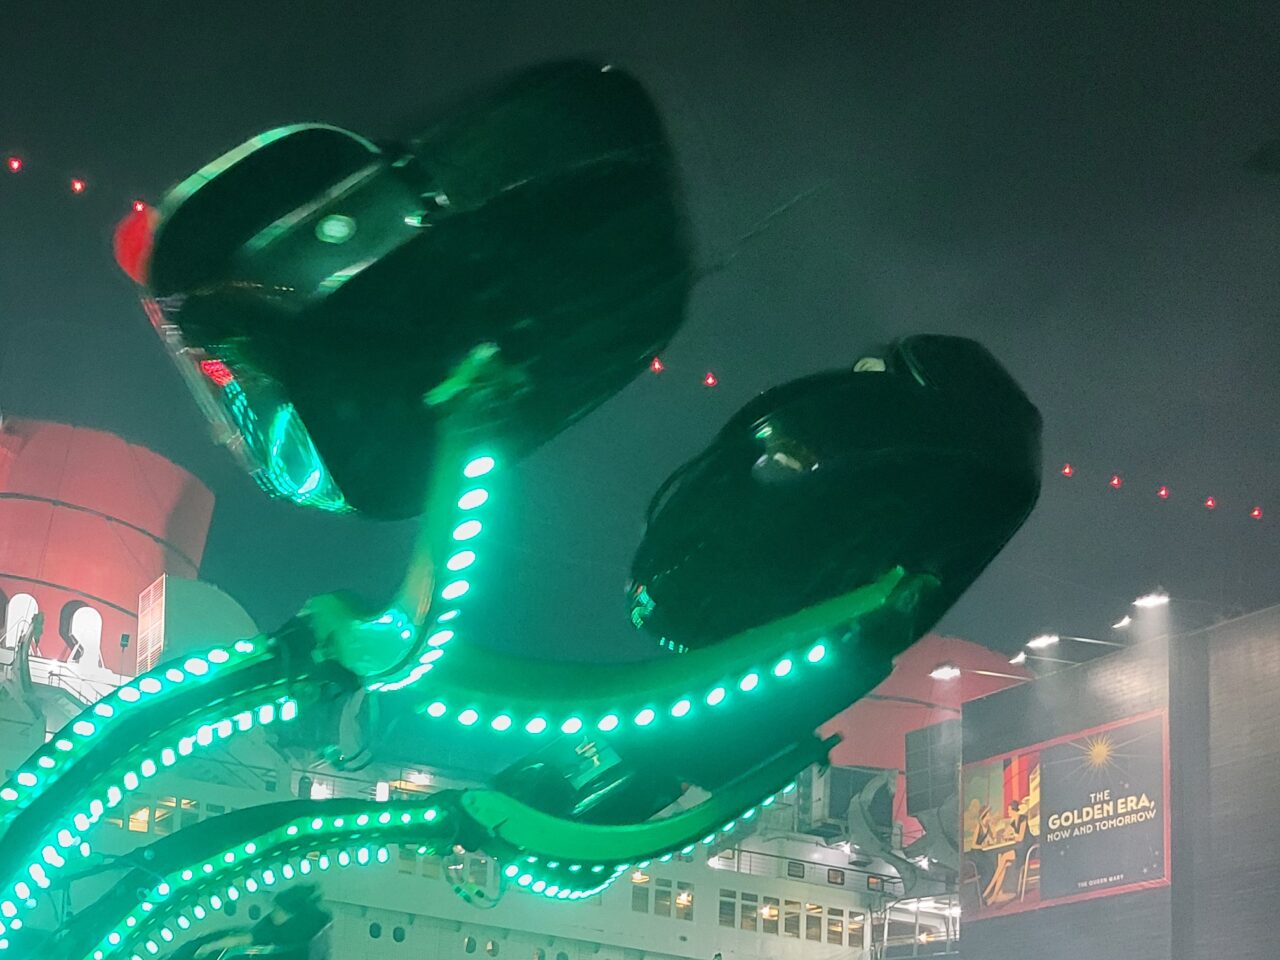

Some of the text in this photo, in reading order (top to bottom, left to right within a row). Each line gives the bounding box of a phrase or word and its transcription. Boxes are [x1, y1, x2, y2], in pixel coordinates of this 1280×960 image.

[1048, 793, 1155, 830] GOLDEN ERA,
[1089, 789, 1111, 804] THE
[1047, 809, 1157, 842] NOW AND TOMORROW
